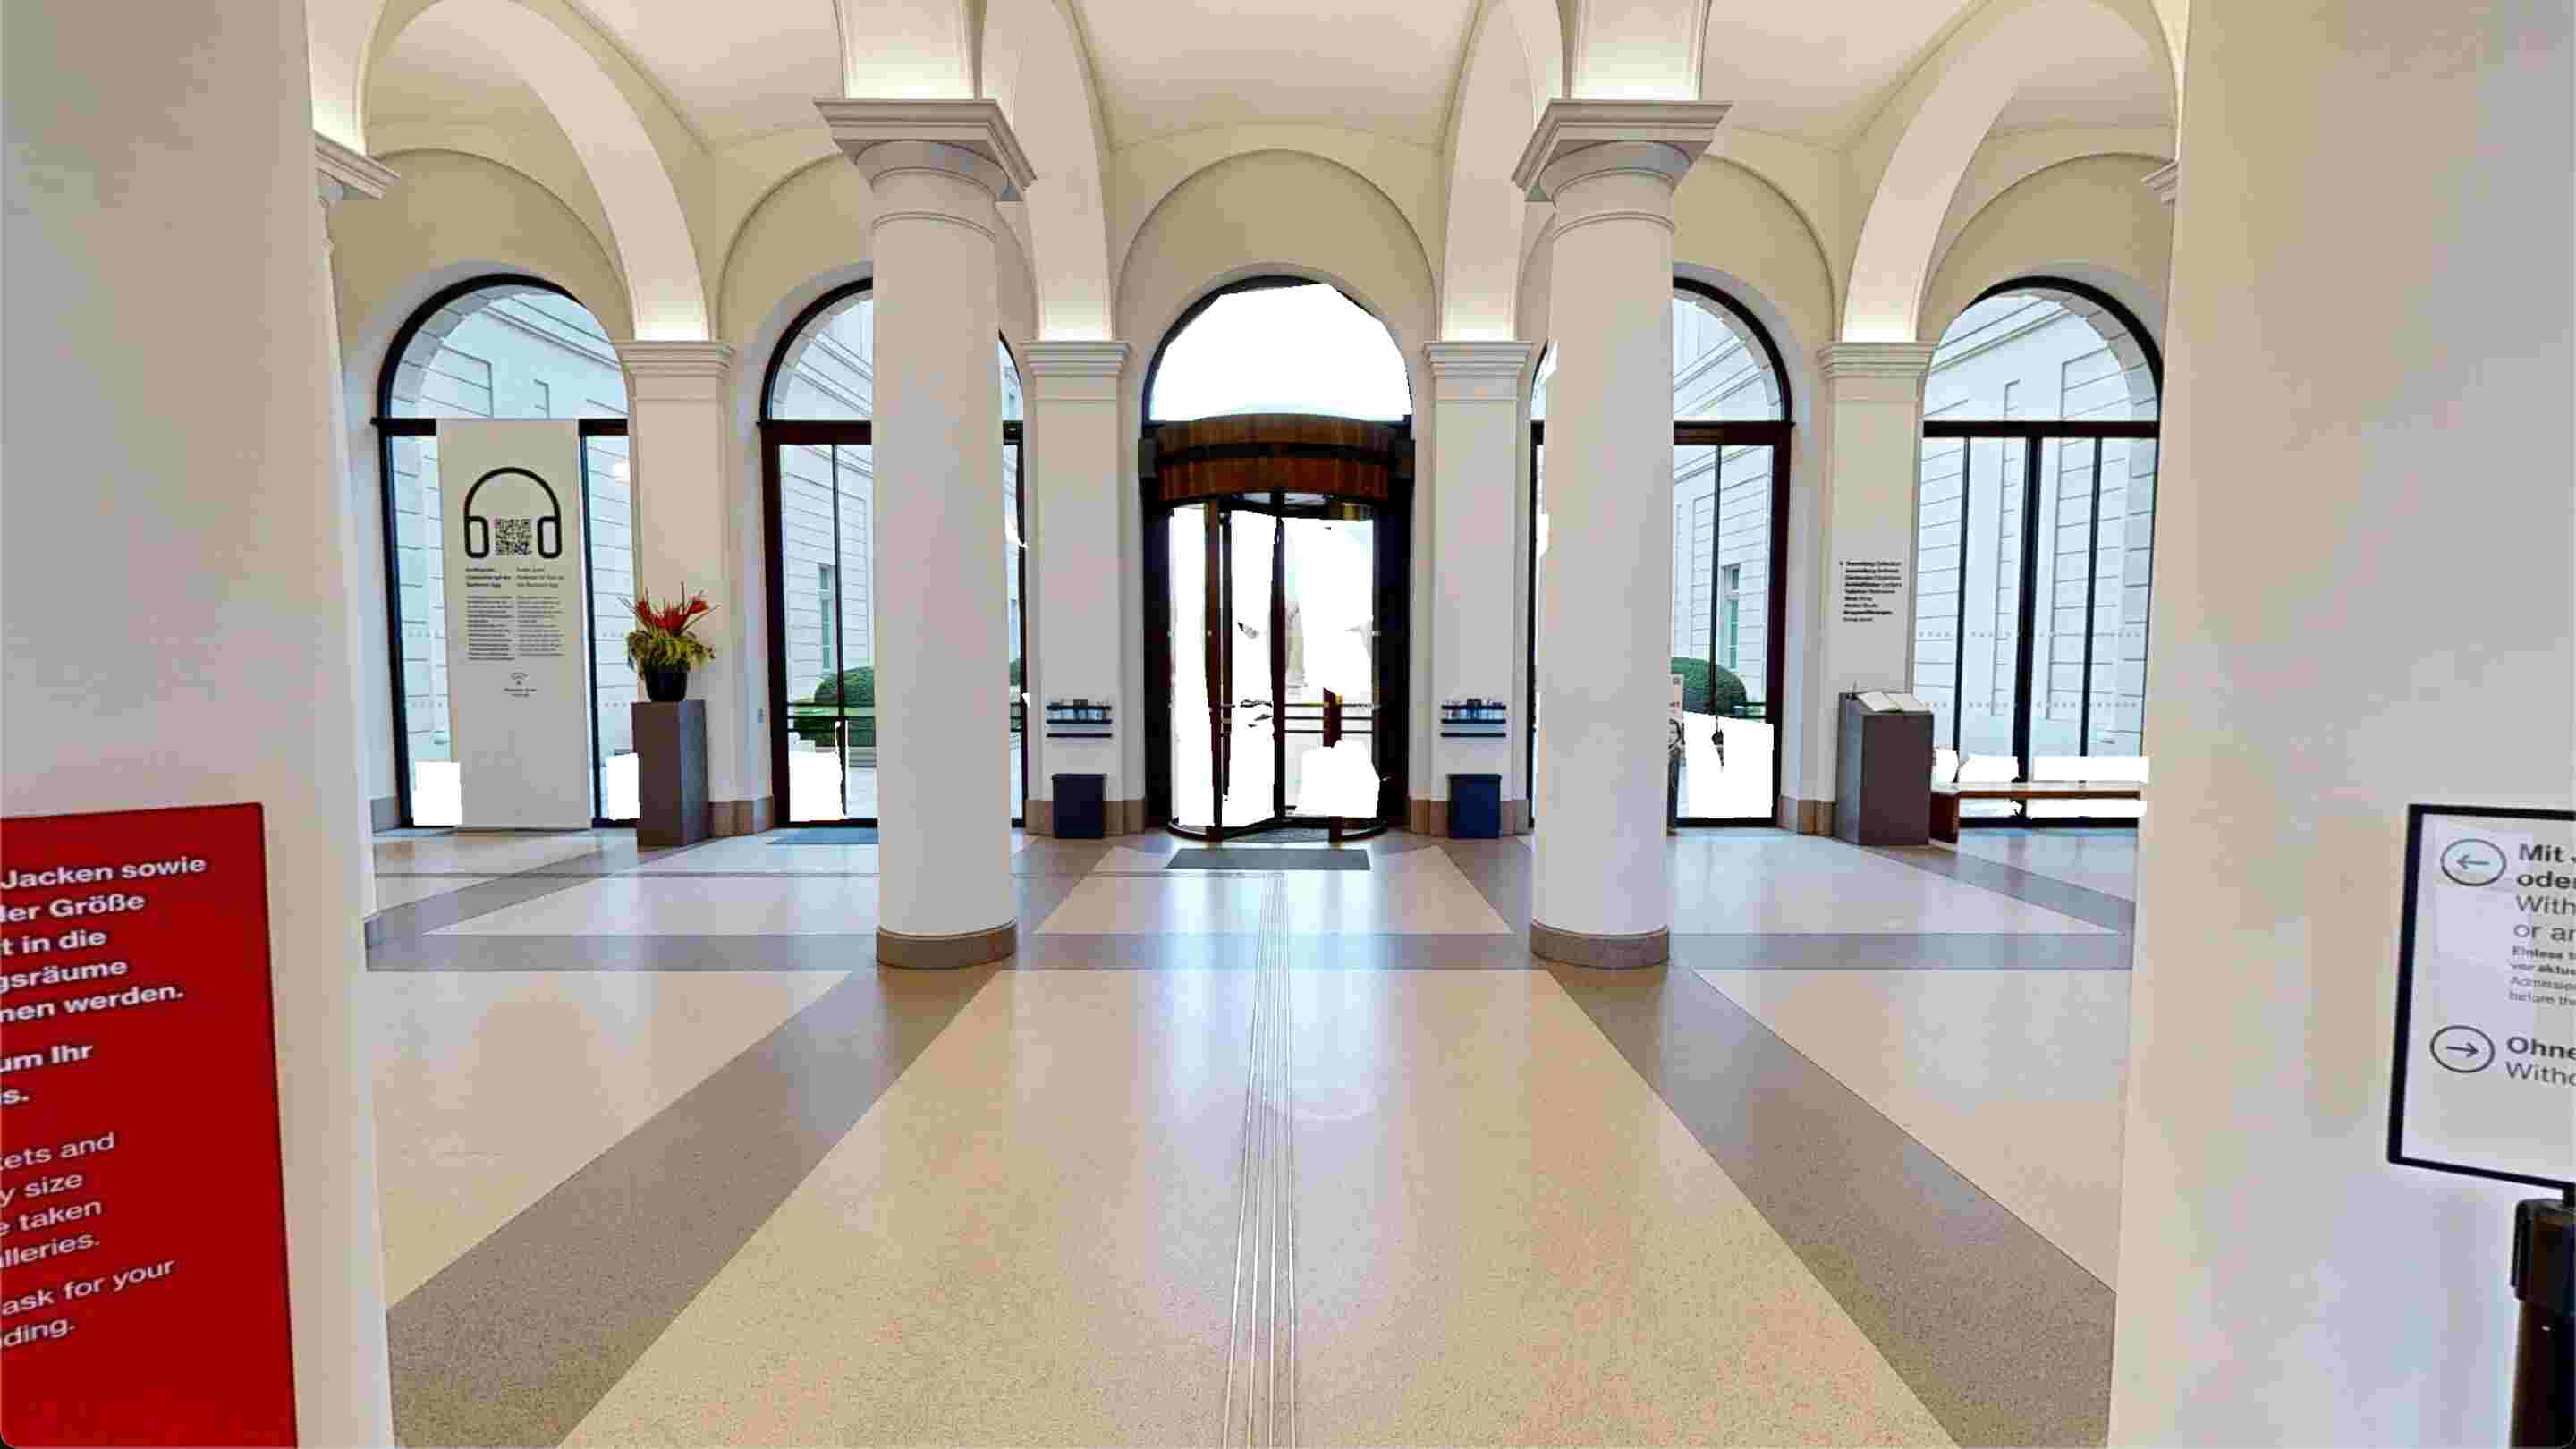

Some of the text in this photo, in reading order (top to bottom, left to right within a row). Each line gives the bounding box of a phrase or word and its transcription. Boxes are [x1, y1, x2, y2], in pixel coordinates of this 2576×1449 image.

[2519, 843, 2564, 863] Mit
[0, 856, 207, 889] Jacken sowie
[0, 894, 145, 923] er Größe
[22, 935, 51, 953] in
[58, 929, 107, 949] die
[2512, 923, 2543, 938] or
[64, 986, 184, 1013] werden.
[51, 1044, 93, 1063] Ihr
[61, 1132, 115, 1159] and
[25, 1174, 83, 1198] size
[20, 1199, 102, 1231] taken
[0, 1233, 100, 1267] lleries.
[2, 1259, 175, 1316] ask for your
